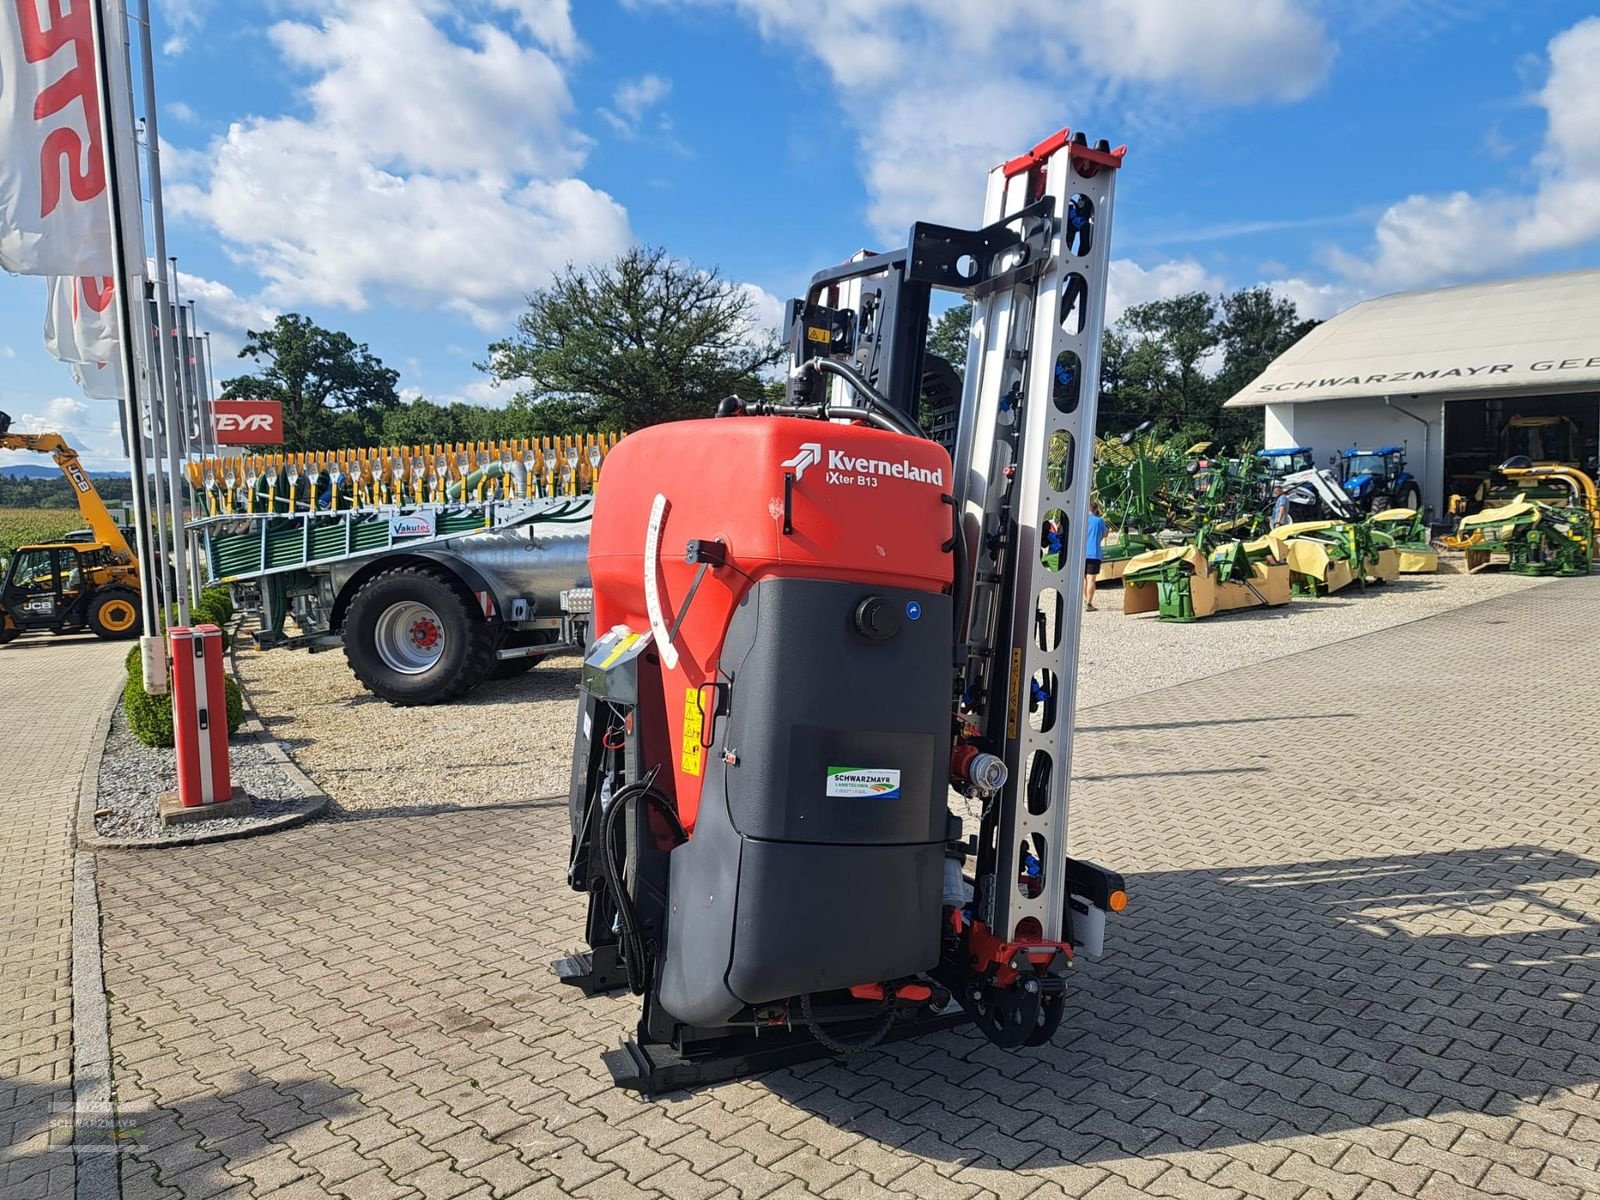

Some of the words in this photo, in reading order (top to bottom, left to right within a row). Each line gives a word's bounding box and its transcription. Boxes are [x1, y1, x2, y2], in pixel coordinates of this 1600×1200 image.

[1256, 364, 1513, 393] SCHWARZMAYR
[829, 450, 943, 486] Kverneland
[67, 465, 90, 492] JCB
[826, 471, 854, 485] iXter
[857, 477, 878, 488] B13
[394, 522, 430, 535] Vakutec
[23, 602, 52, 610] JCB
[835, 775, 890, 783] SCHWARZMAYR
